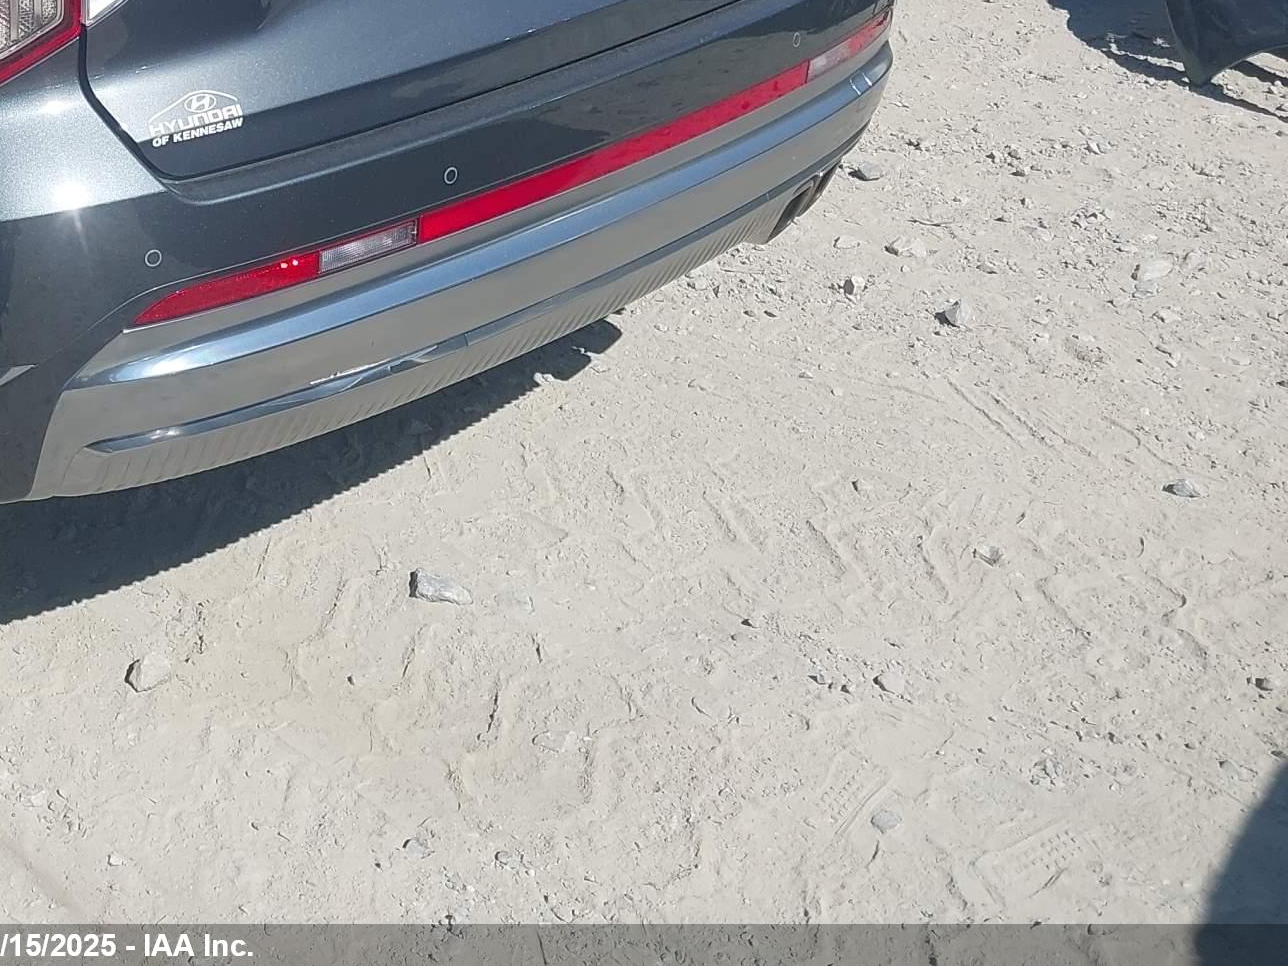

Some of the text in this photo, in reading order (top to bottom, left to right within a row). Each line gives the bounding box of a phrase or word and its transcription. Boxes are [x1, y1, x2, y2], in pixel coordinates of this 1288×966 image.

[149, 103, 243, 136] HYUNDAI
[152, 117, 244, 148] OF KENNESAW
